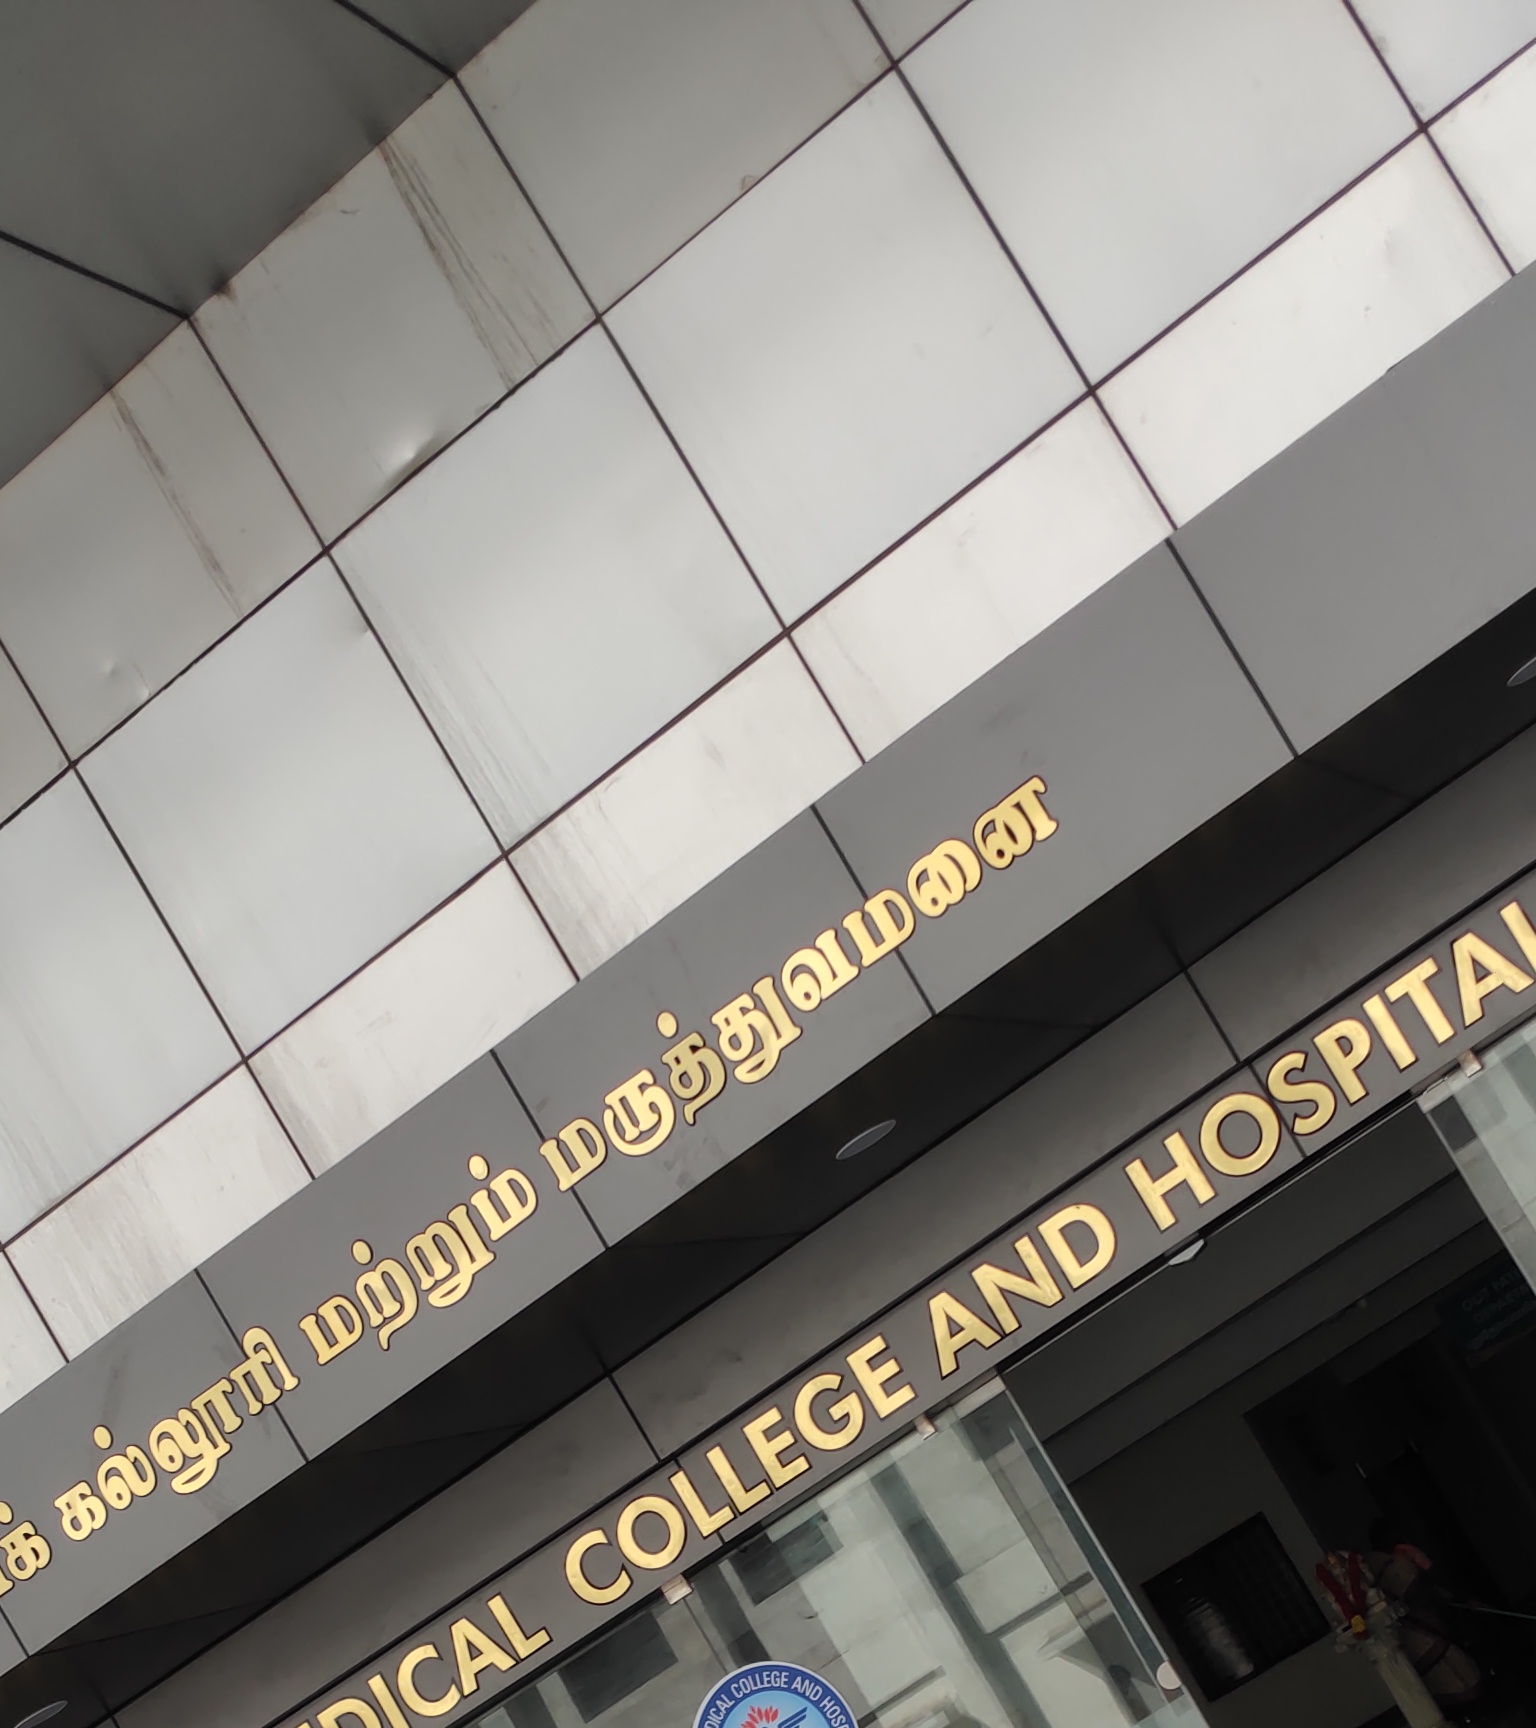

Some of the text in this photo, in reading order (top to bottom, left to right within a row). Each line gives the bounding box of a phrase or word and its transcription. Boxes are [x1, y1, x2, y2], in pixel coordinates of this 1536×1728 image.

[55, 1327, 299, 1542] கல்லூரி
[298, 1153, 538, 1349] மற்றும்
[539, 776, 1059, 1192] மருத்துவமனை
[563, 1333, 917, 1606] COLLEGE
[926, 1202, 1119, 1380] AND
[730, 1671, 789, 1699] COLLEGE
[791, 1675, 824, 1702] AND
